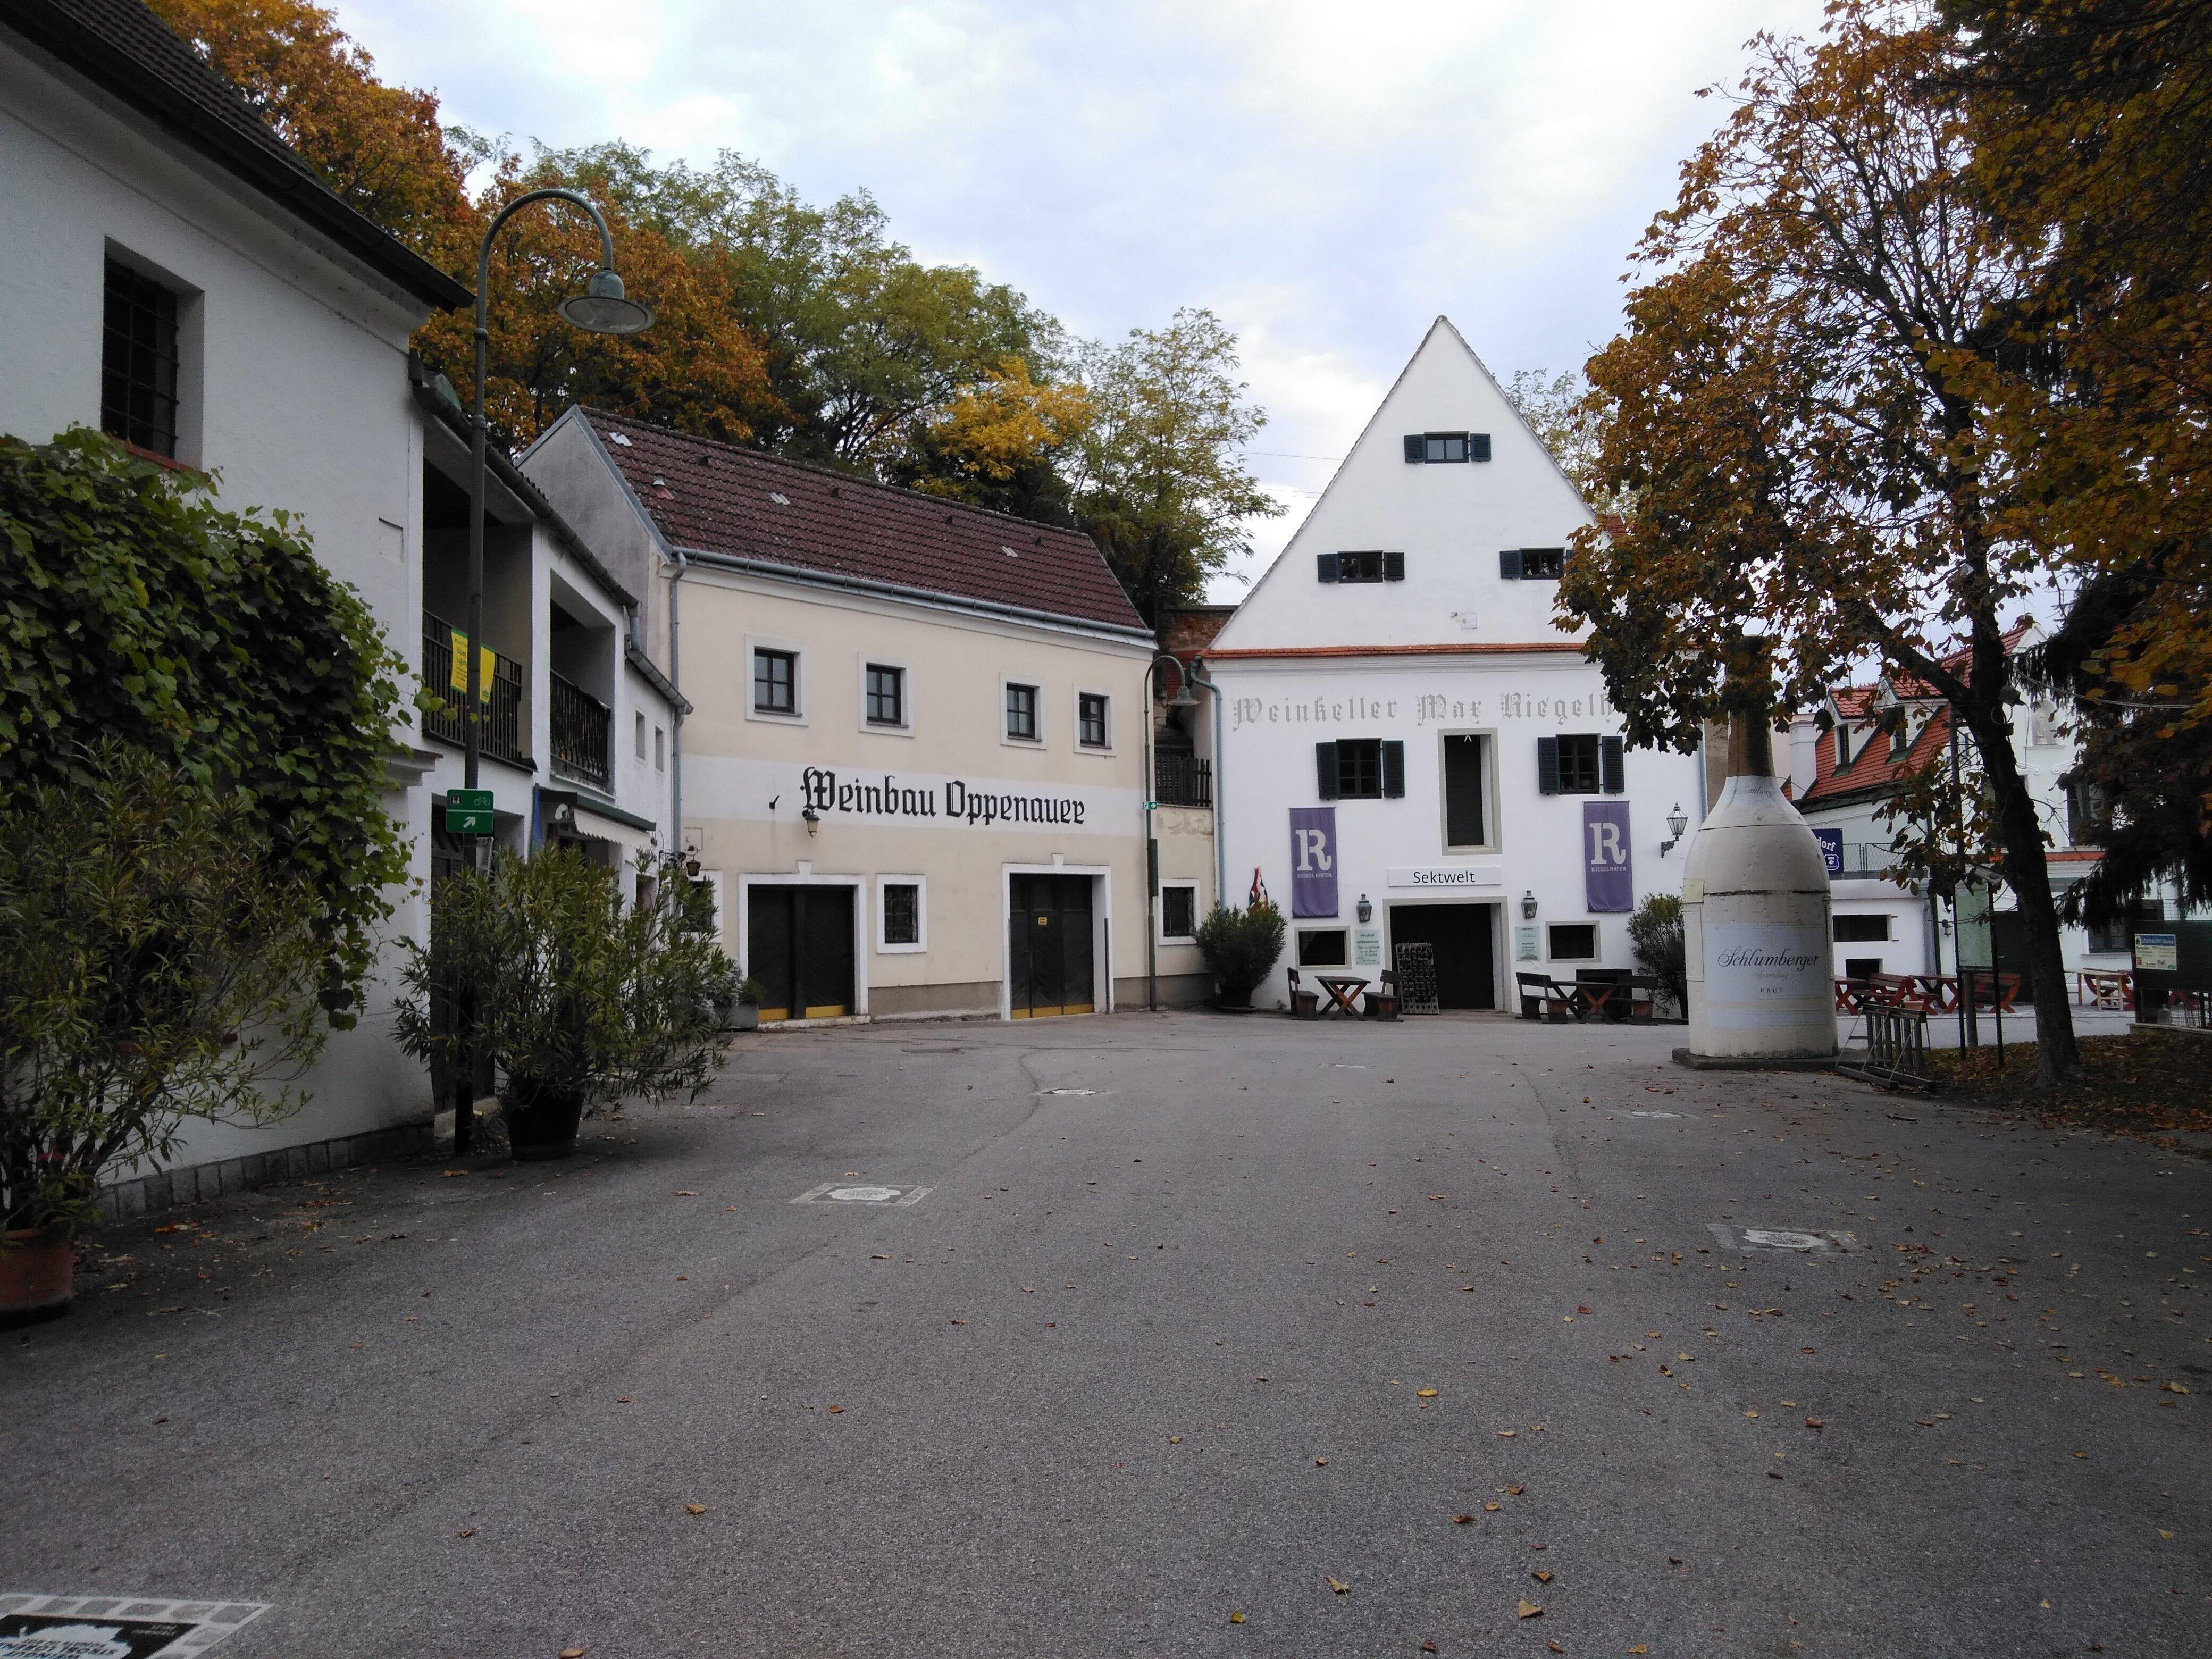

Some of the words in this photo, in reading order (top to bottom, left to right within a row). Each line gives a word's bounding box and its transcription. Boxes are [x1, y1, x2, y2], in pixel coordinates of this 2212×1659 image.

[1231, 694, 1397, 732] Weinkeller
[1415, 693, 1482, 726] Max
[800, 766, 936, 817] Weinbau
[946, 780, 1085, 826] Oppenauer
[1295, 830, 1331, 871] R
[1589, 823, 1626, 865] R
[1413, 870, 1476, 883] Sektwelt
[1717, 945, 1819, 972] Schlumberger
